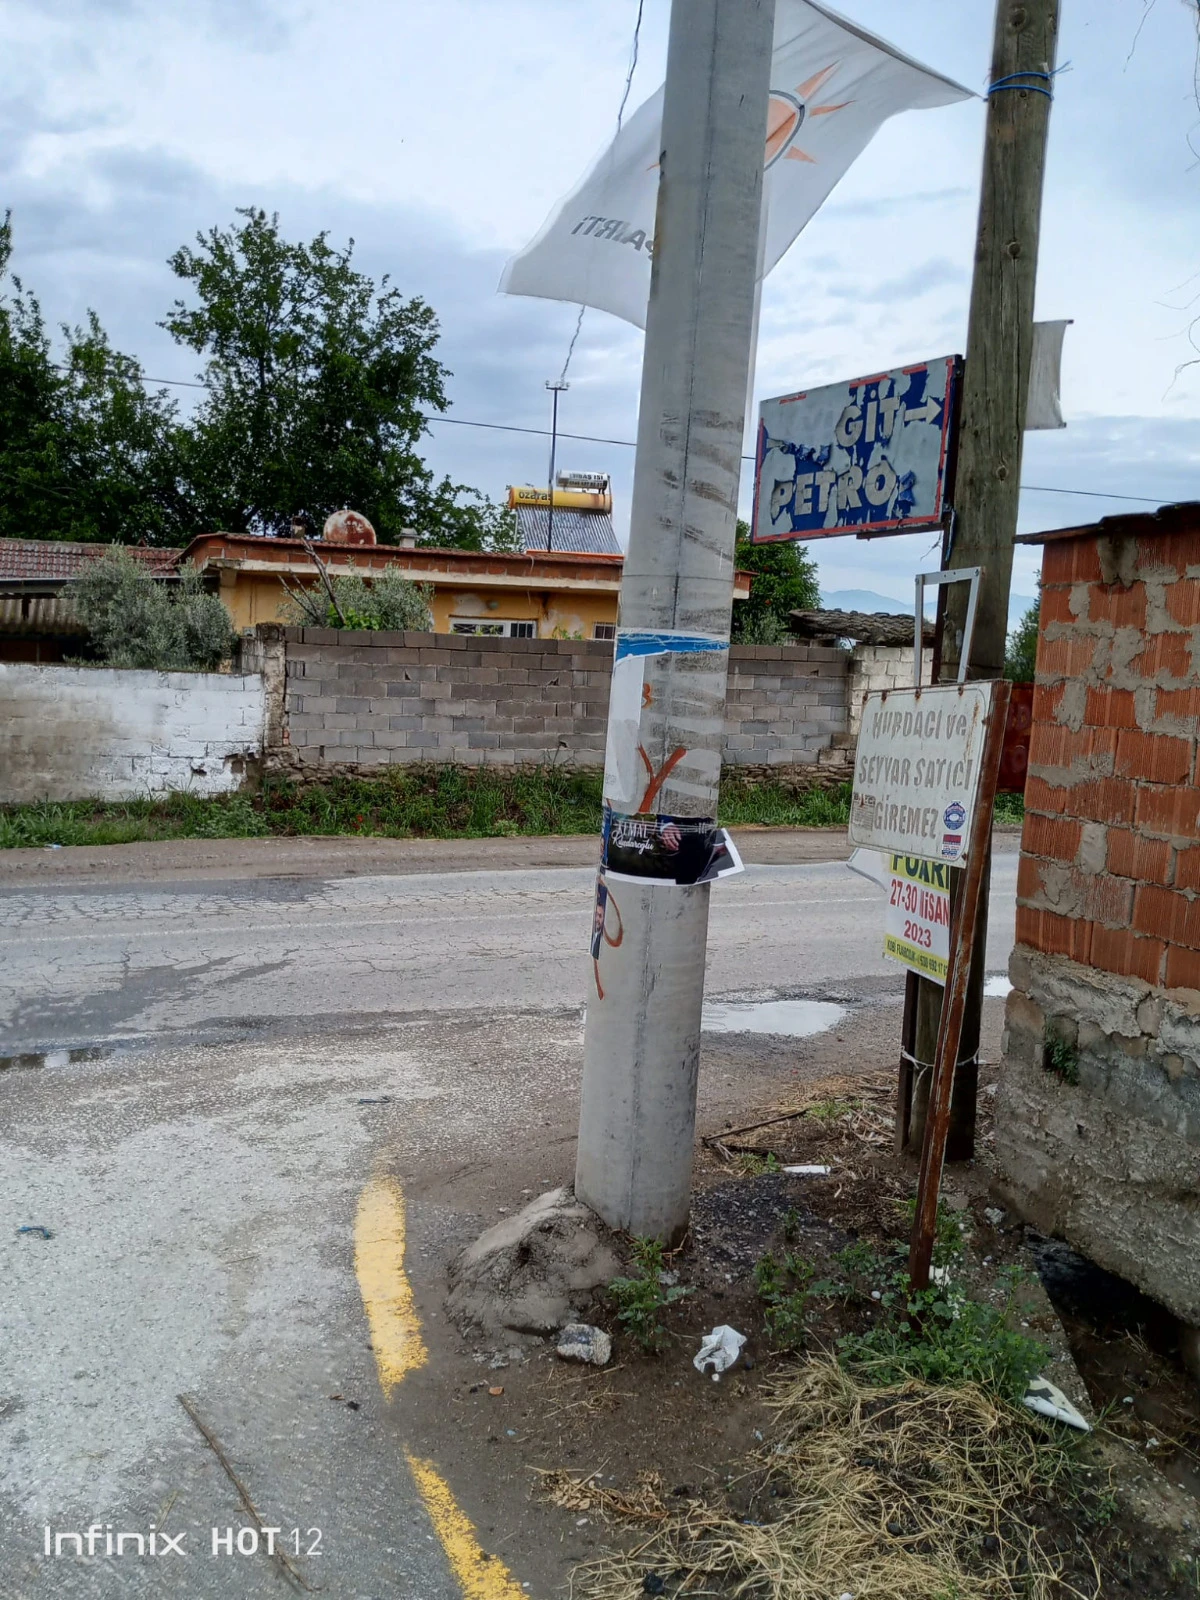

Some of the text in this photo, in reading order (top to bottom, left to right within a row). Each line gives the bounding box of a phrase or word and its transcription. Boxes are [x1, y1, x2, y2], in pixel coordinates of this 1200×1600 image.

[834, 389, 900, 447] GİT
[859, 755, 973, 790] SEYYAR SATICI
[890, 879, 917, 914] 27-30
[904, 920, 932, 948] 2023
